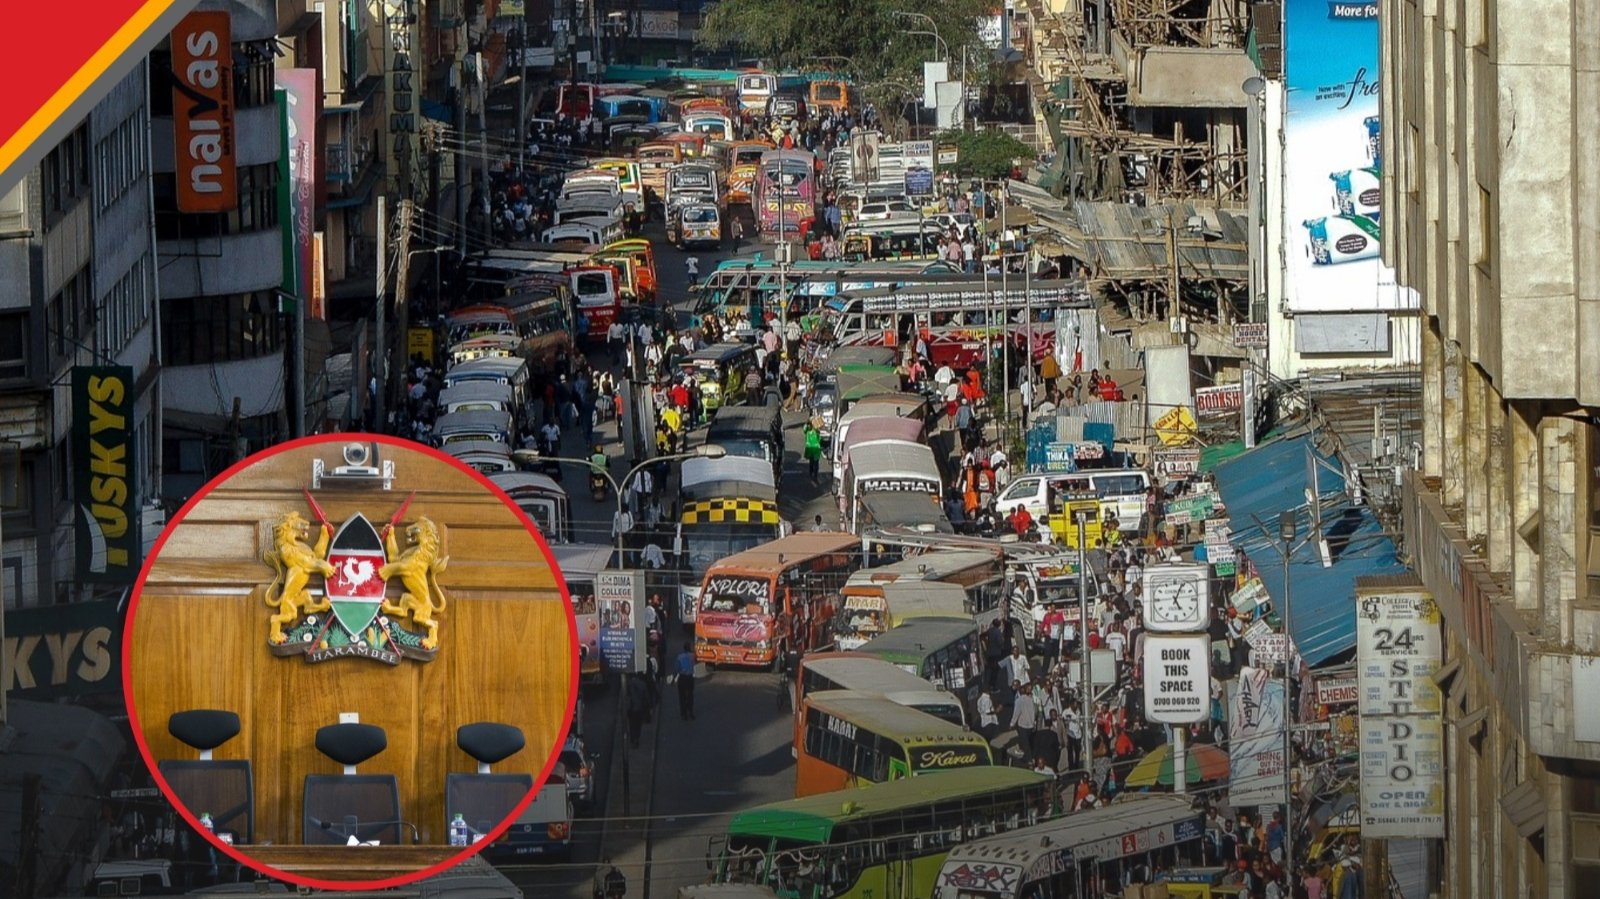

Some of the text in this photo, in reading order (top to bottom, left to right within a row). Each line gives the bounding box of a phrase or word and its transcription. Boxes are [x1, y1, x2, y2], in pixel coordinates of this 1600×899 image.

[1335, 4, 1362, 16] More
[183, 31, 223, 192] naivas
[1198, 391, 1241, 411] BOOKSH
[1046, 451, 1069, 460] THIKA
[84, 375, 129, 571] TUSKYS
[864, 480, 936, 493] MARTIAL
[706, 578, 769, 597] XPLORA
[1373, 627, 1414, 650] 24
[313, 646, 395, 662] HARAMBEE
[1161, 649, 1190, 660] BOOK
[1164, 665, 1188, 676] THIS
[1160, 681, 1193, 692] SPACE
[1320, 685, 1358, 701] CHEMIS
[1388, 659, 1413, 781] STUDIO
[1379, 791, 1425, 799] OPEN
